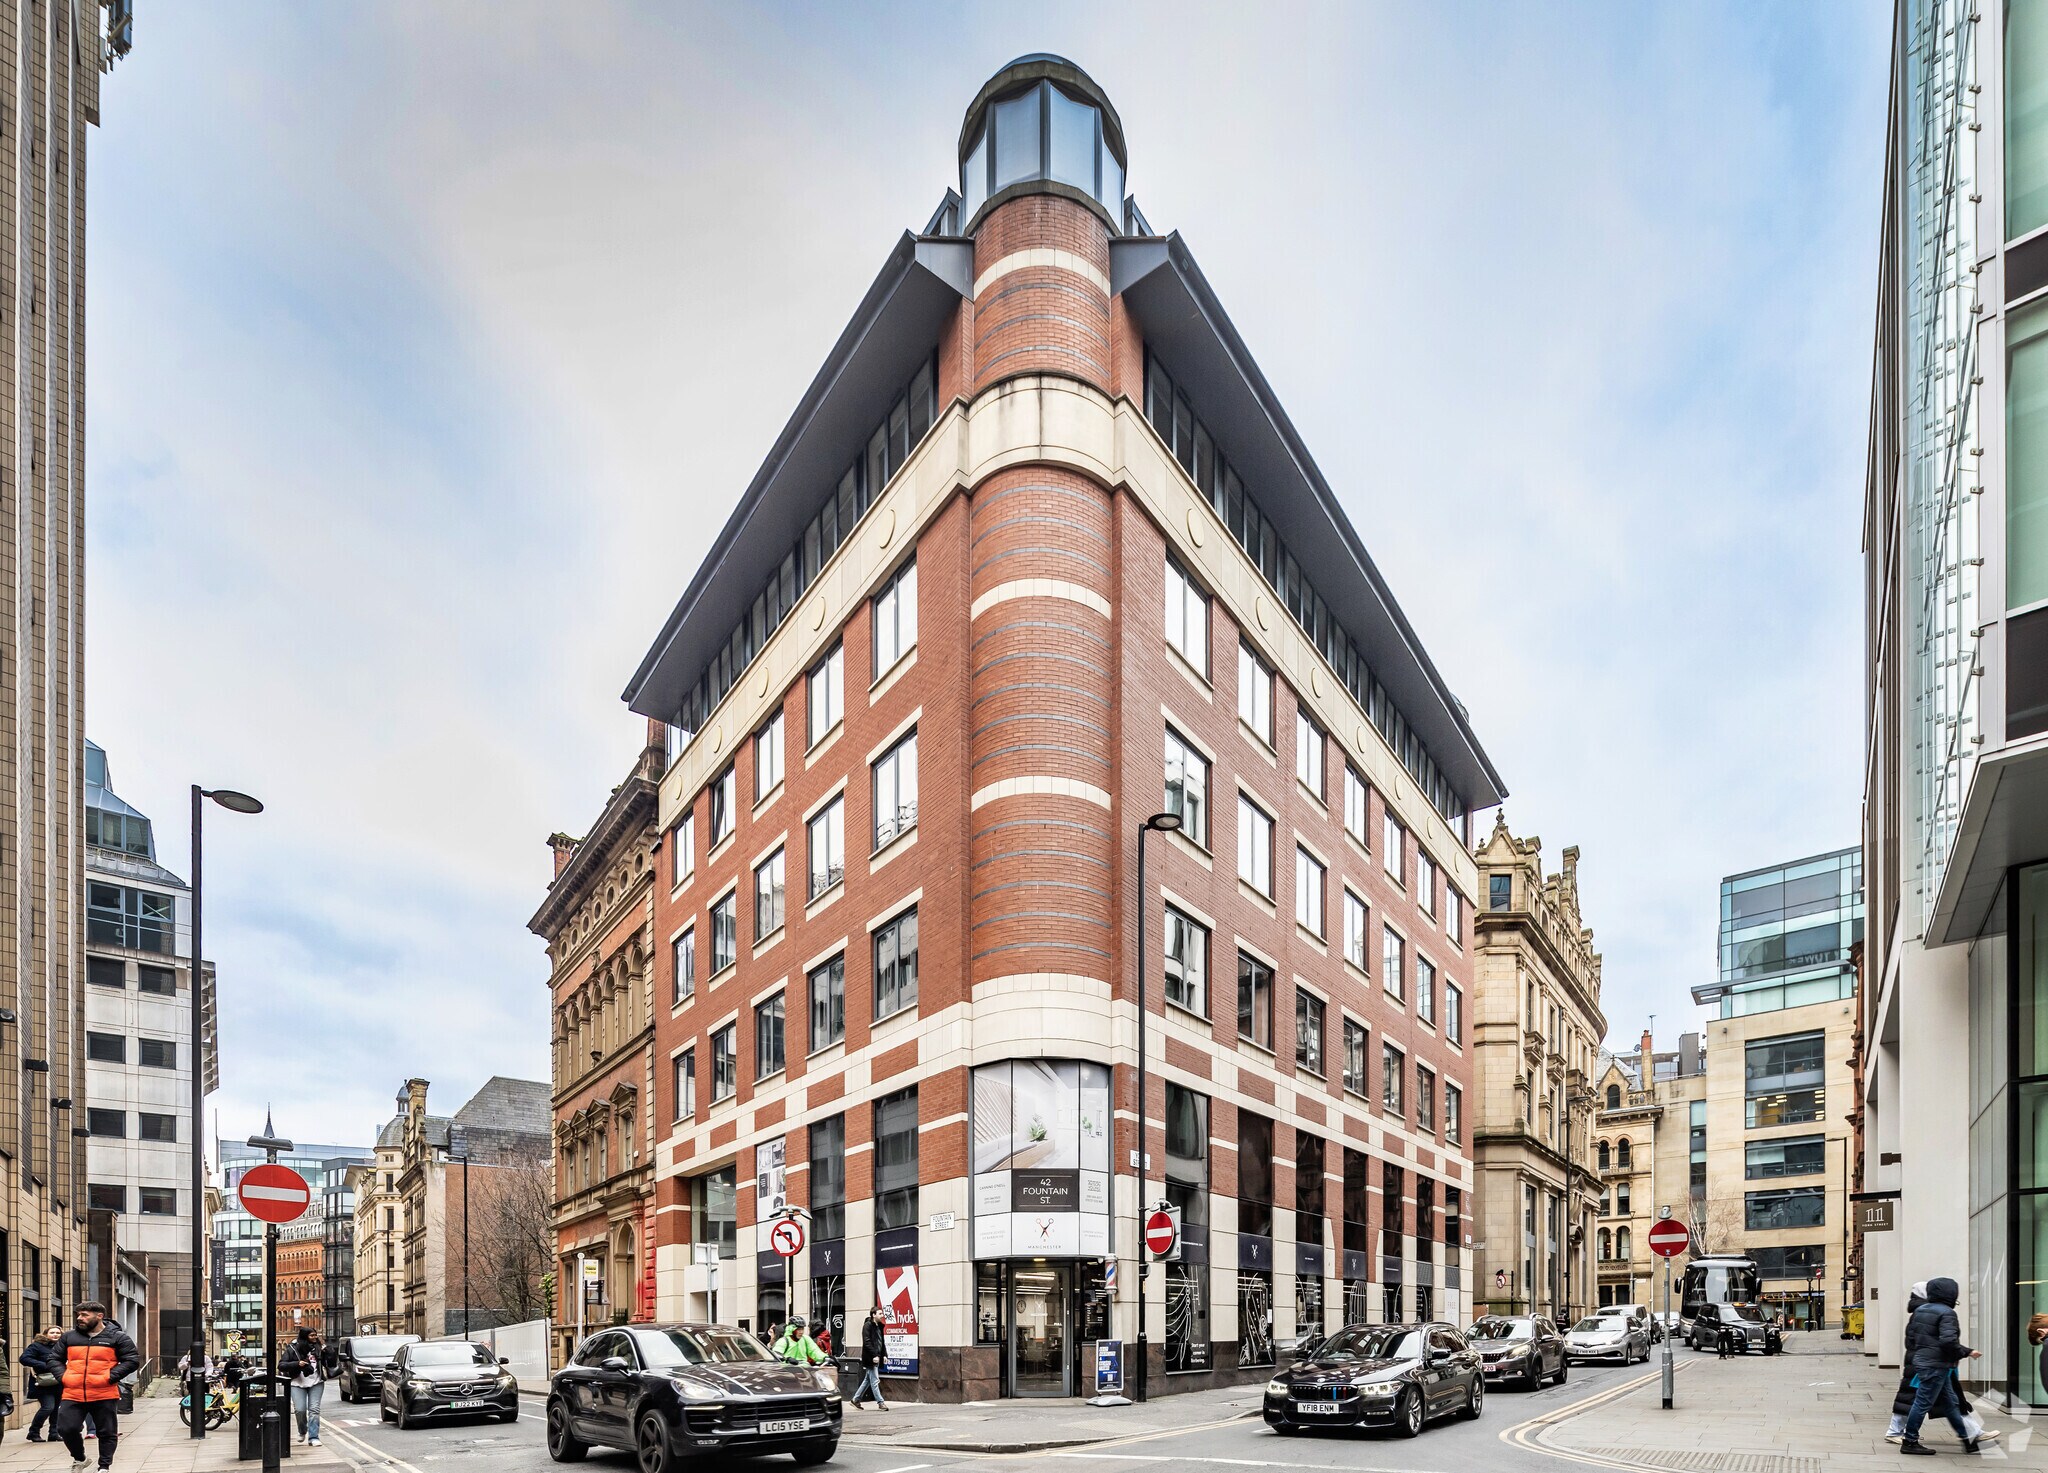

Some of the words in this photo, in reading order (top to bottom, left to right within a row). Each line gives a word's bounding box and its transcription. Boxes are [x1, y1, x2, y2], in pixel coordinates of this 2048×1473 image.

[1040, 1178, 1051, 1186] 42
[1023, 1187, 1068, 1195] FOUNTAIN
[1040, 1196, 1050, 1204] ST.
[932, 1214, 952, 1222] FOUNTAIN
[1866, 1207, 1884, 1222] 11
[935, 1221, 949, 1229] STREET
[897, 1310, 914, 1327] hyde
[765, 1422, 786, 1432] LC15
[787, 1420, 804, 1430] YSE
